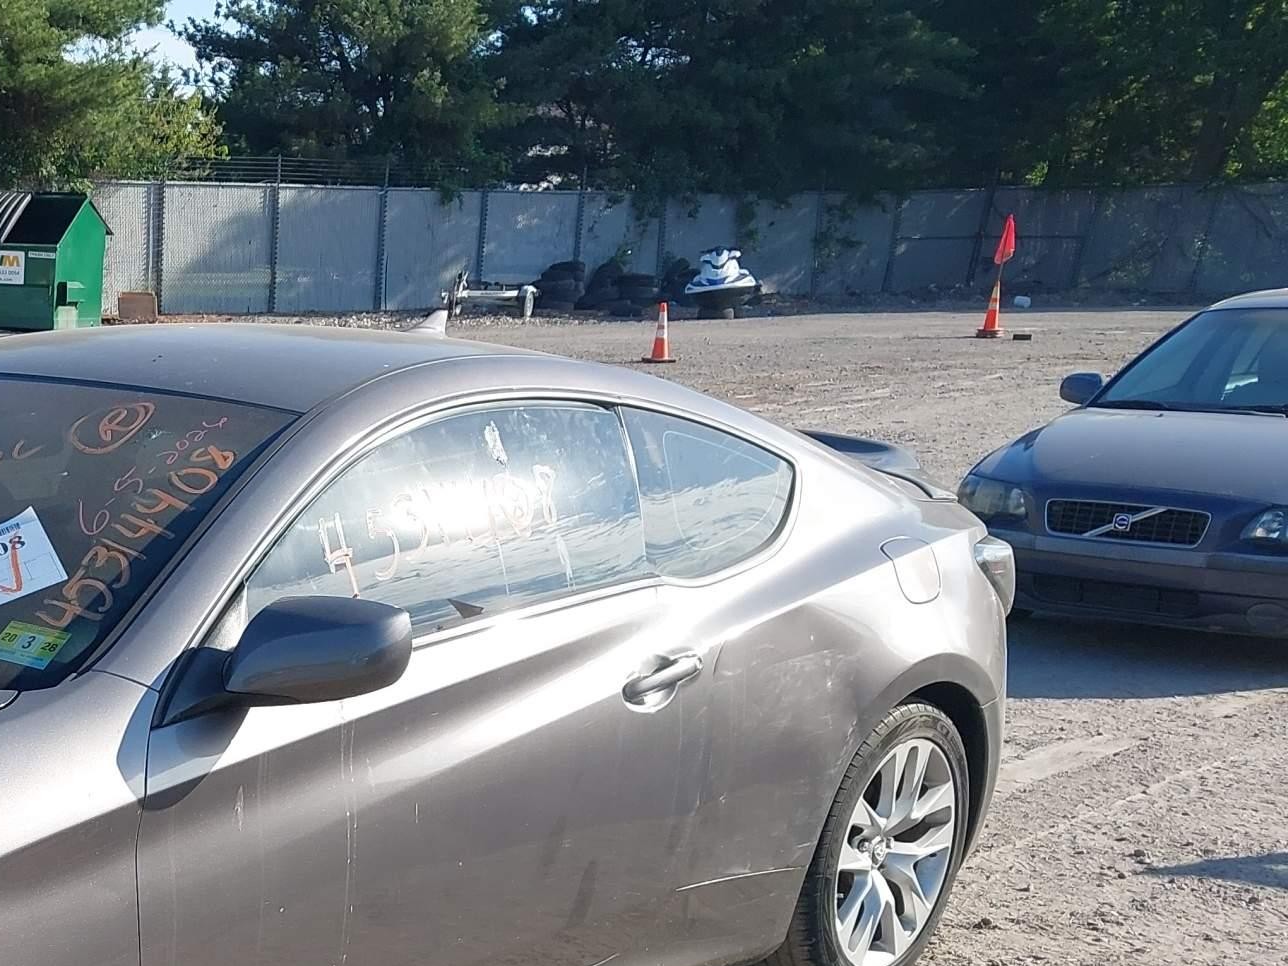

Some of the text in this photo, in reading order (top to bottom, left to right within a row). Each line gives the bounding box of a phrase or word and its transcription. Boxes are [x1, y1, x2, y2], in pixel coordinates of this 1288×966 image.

[35, 445, 235, 628] 45314408
[1, 632, 18, 643] 20
[21, 635, 36, 649] 3
